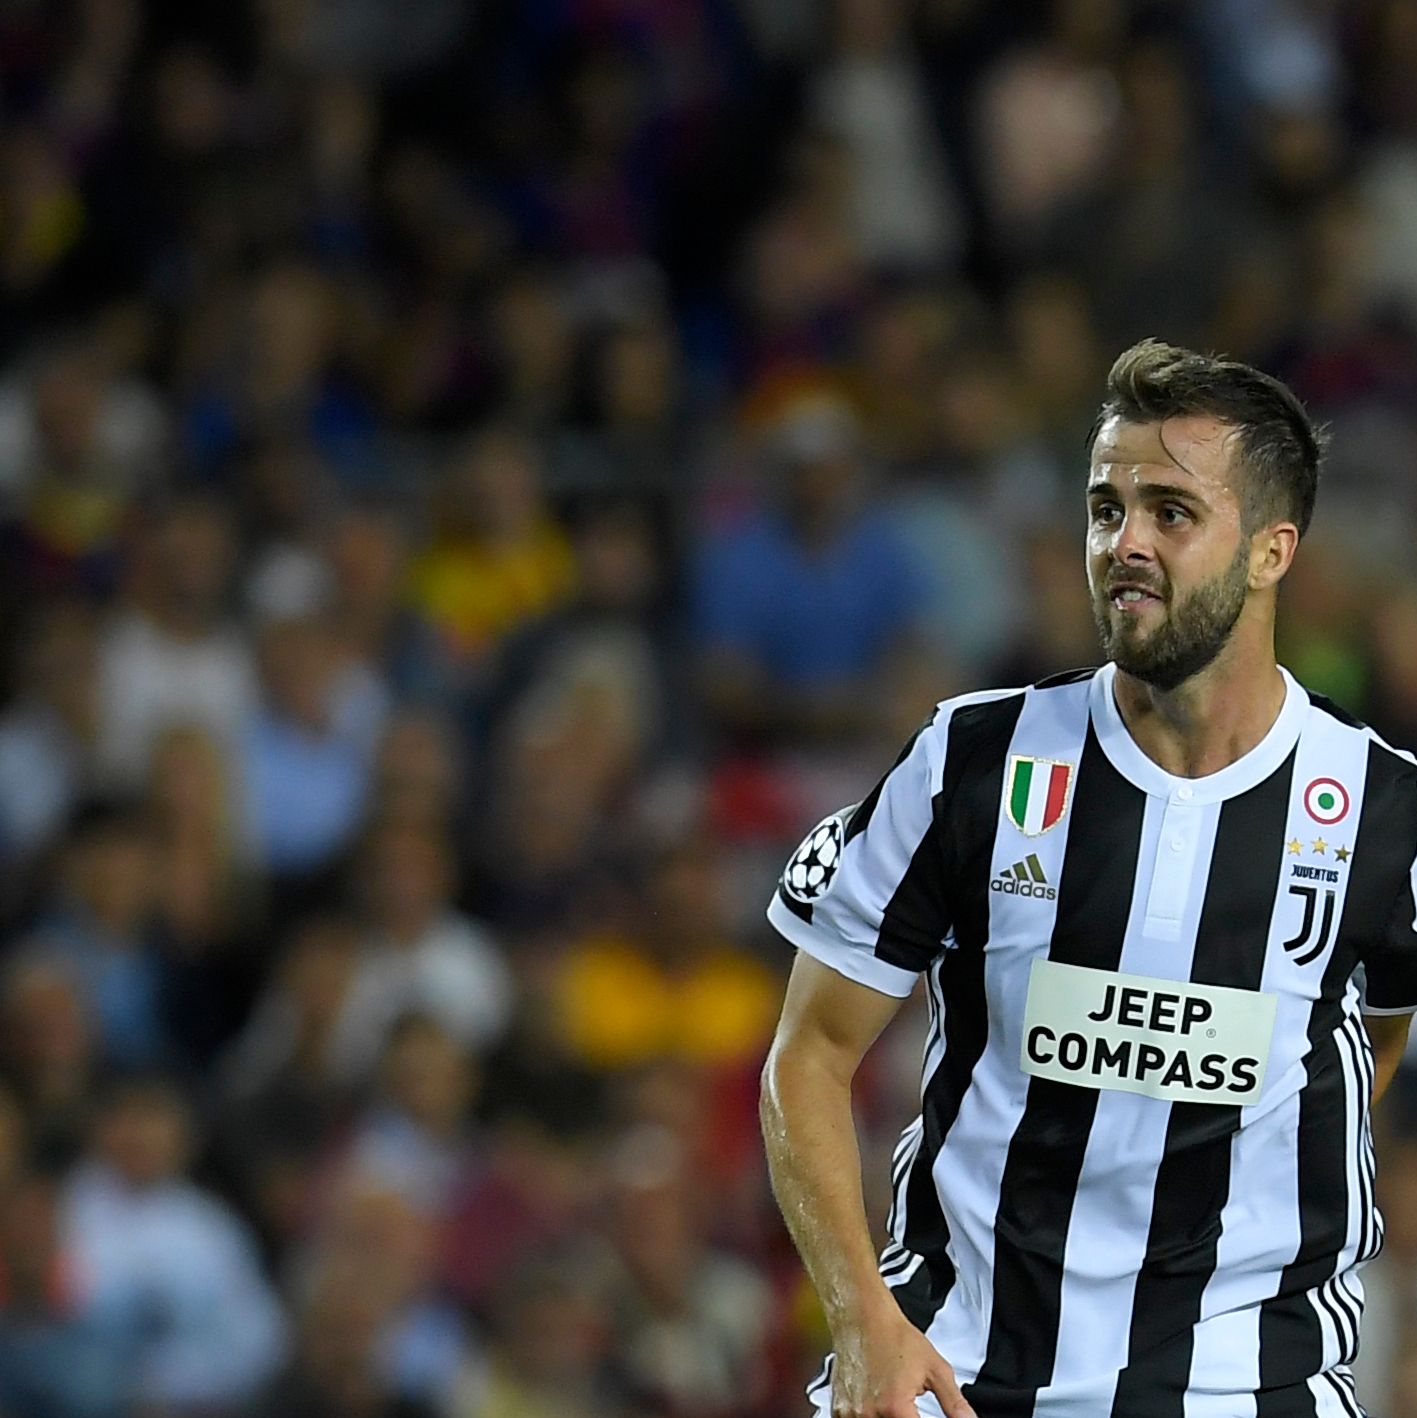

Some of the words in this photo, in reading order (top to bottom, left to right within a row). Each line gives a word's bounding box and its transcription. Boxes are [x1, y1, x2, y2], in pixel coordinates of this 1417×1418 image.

[991, 878, 1057, 901] adidas
[1290, 864, 1339, 883] JUVENTUS
[1088, 985, 1213, 1035] JEEP
[1027, 1025, 1260, 1093] COMPASS
